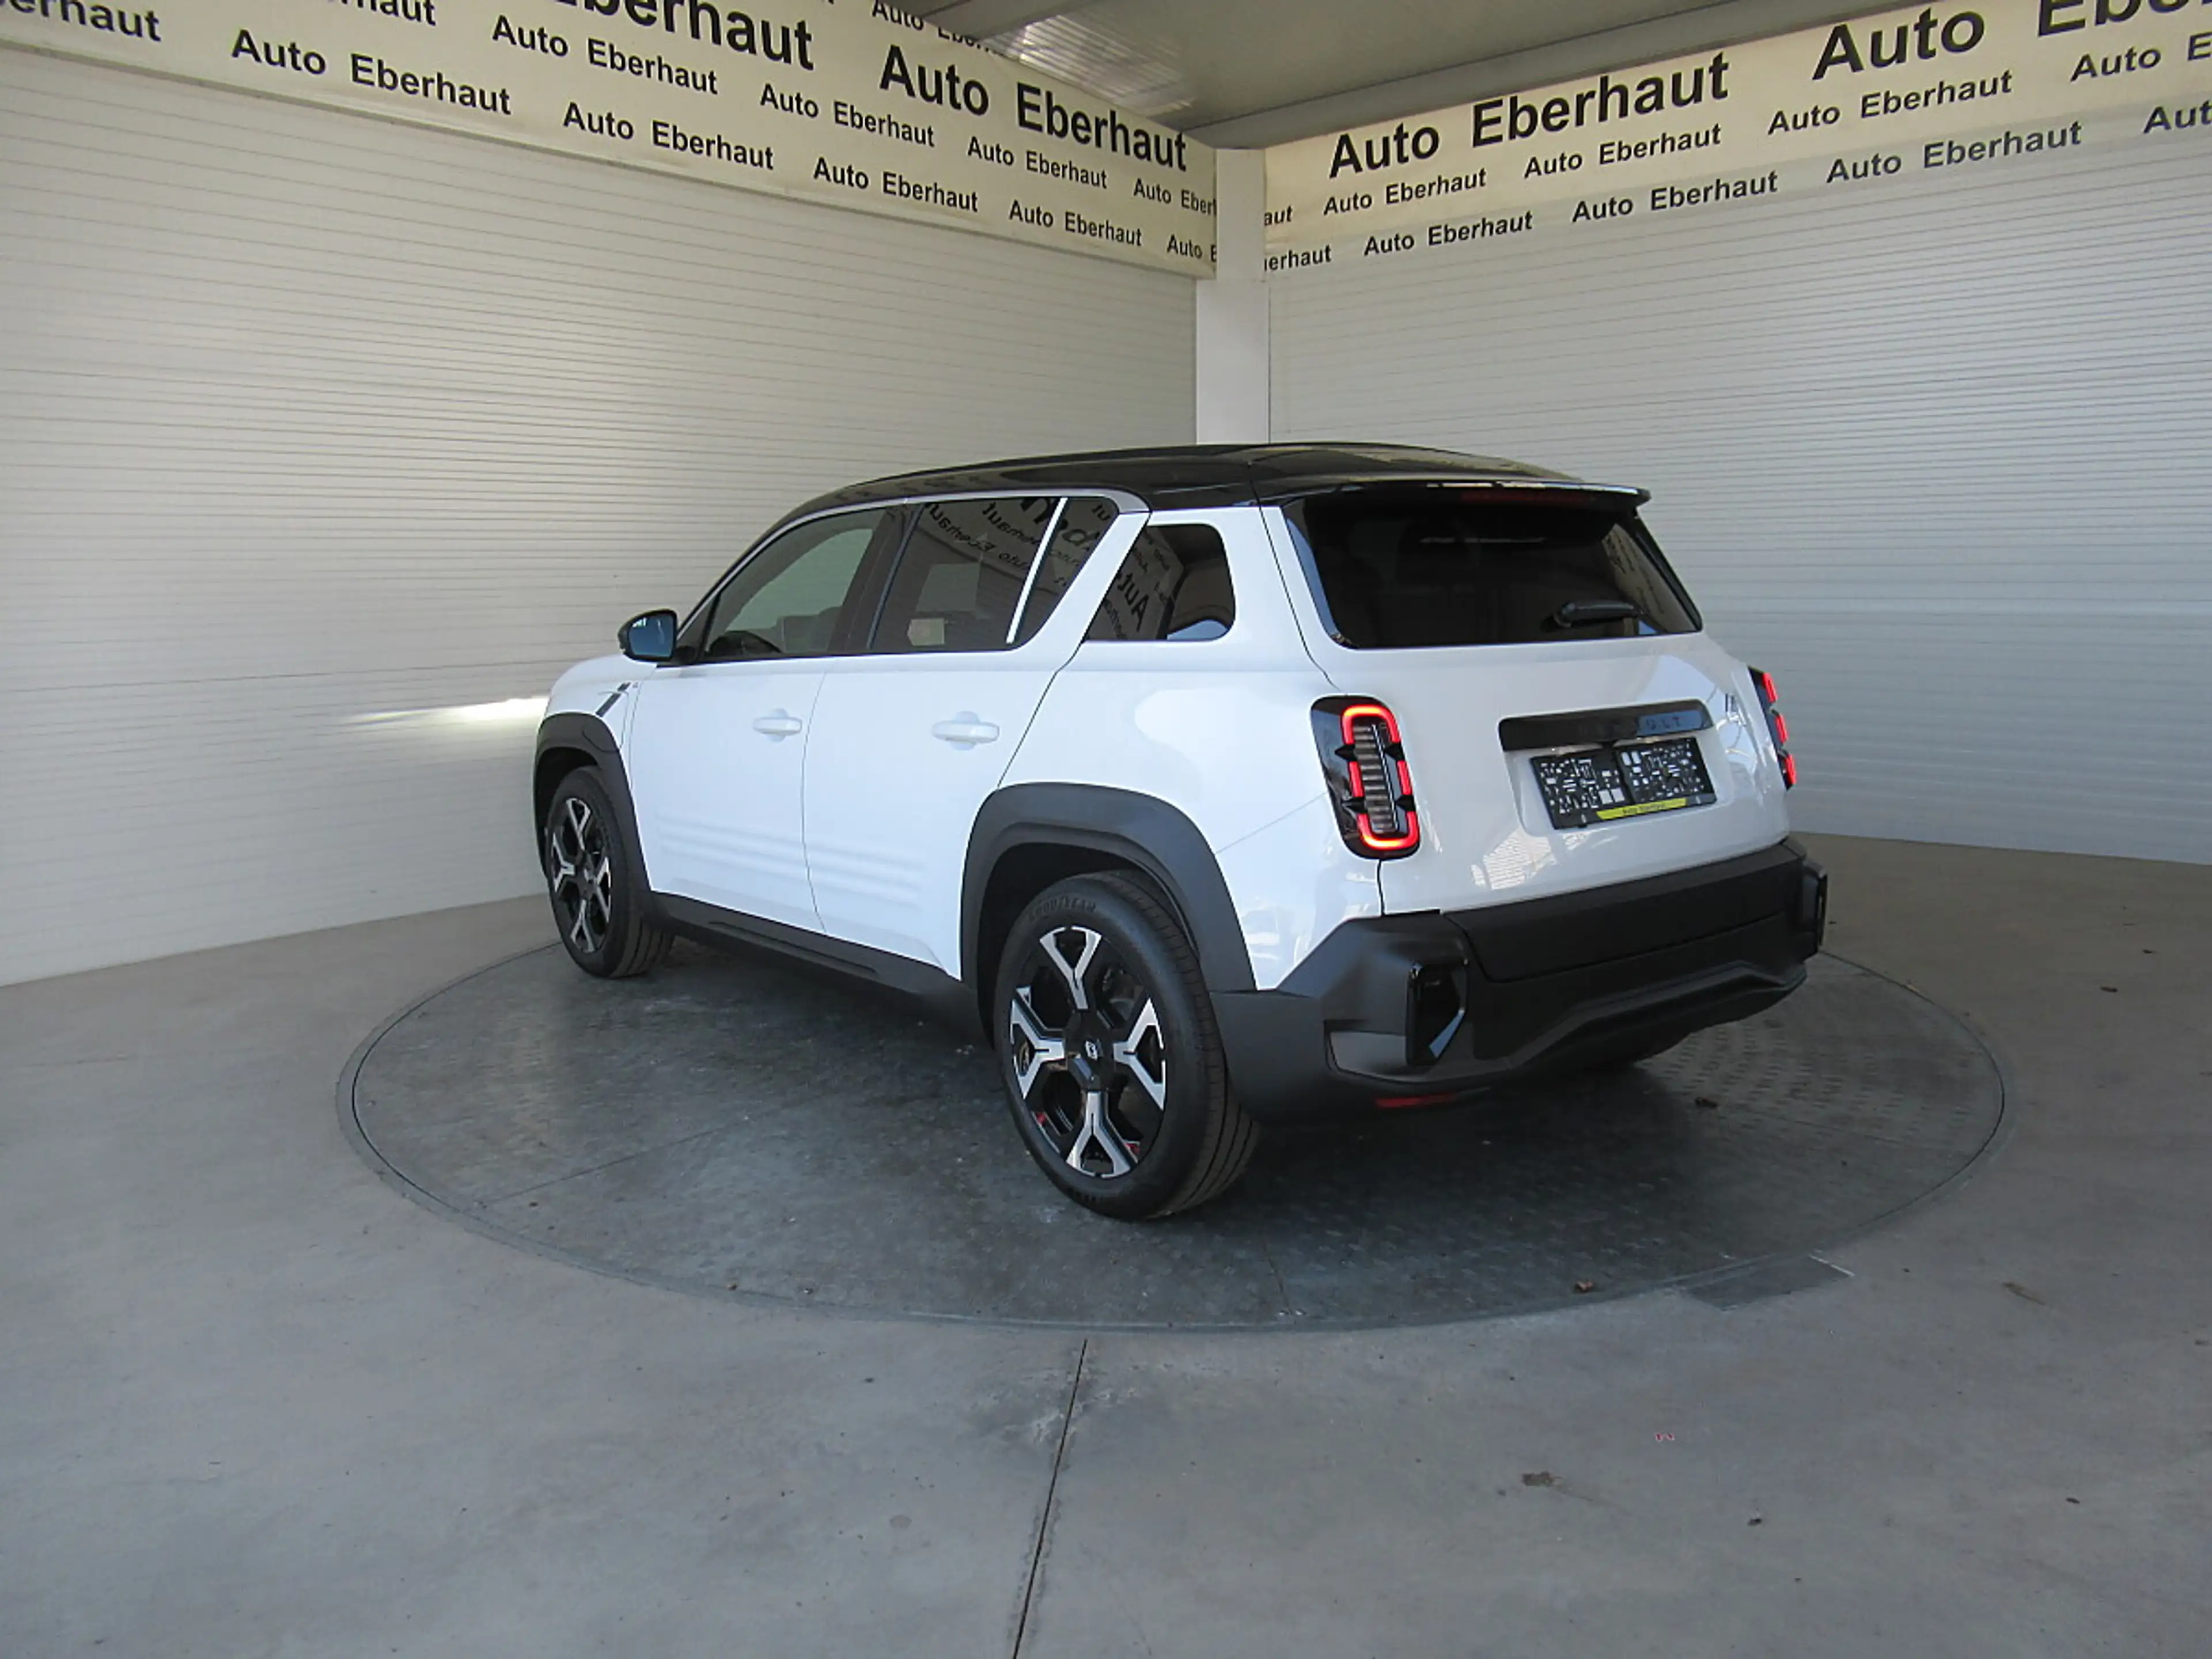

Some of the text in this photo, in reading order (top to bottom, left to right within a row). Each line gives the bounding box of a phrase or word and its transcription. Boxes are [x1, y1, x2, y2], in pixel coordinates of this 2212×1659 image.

[0, 0, 161, 41] erhaut
[557, 0, 814, 70] erhaut
[1812, 9, 1985, 81] Auto
[232, 29, 511, 115] Auto Eberhaut
[493, 15, 718, 95] Auto Eberhaut
[2071, 46, 2161, 82] Auto
[760, 83, 935, 147] Auto Eberhaut
[880, 45, 1187, 172] Auto Eberhaut
[1330, 52, 1729, 179] Auto Eberhaut
[1767, 70, 2012, 135] Auto Eberhaut
[563, 102, 774, 171] Auto Eberhaut
[968, 136, 1108, 189] Auto Eberhaut
[1524, 123, 1721, 179] Auto Eberhaut
[1826, 121, 2081, 183] Auto Eberhaut
[813, 157, 978, 213] Auto Eberhaut
[1133, 178, 1172, 204] Auto
[1323, 168, 1486, 215] Auto Eberhaut
[1572, 171, 1778, 223] Auto Eberhaut
[1009, 199, 1142, 247] Auto Eberhaut
[1166, 234, 1203, 259] Auto
[1363, 211, 1533, 256] Auto Eberhaut
